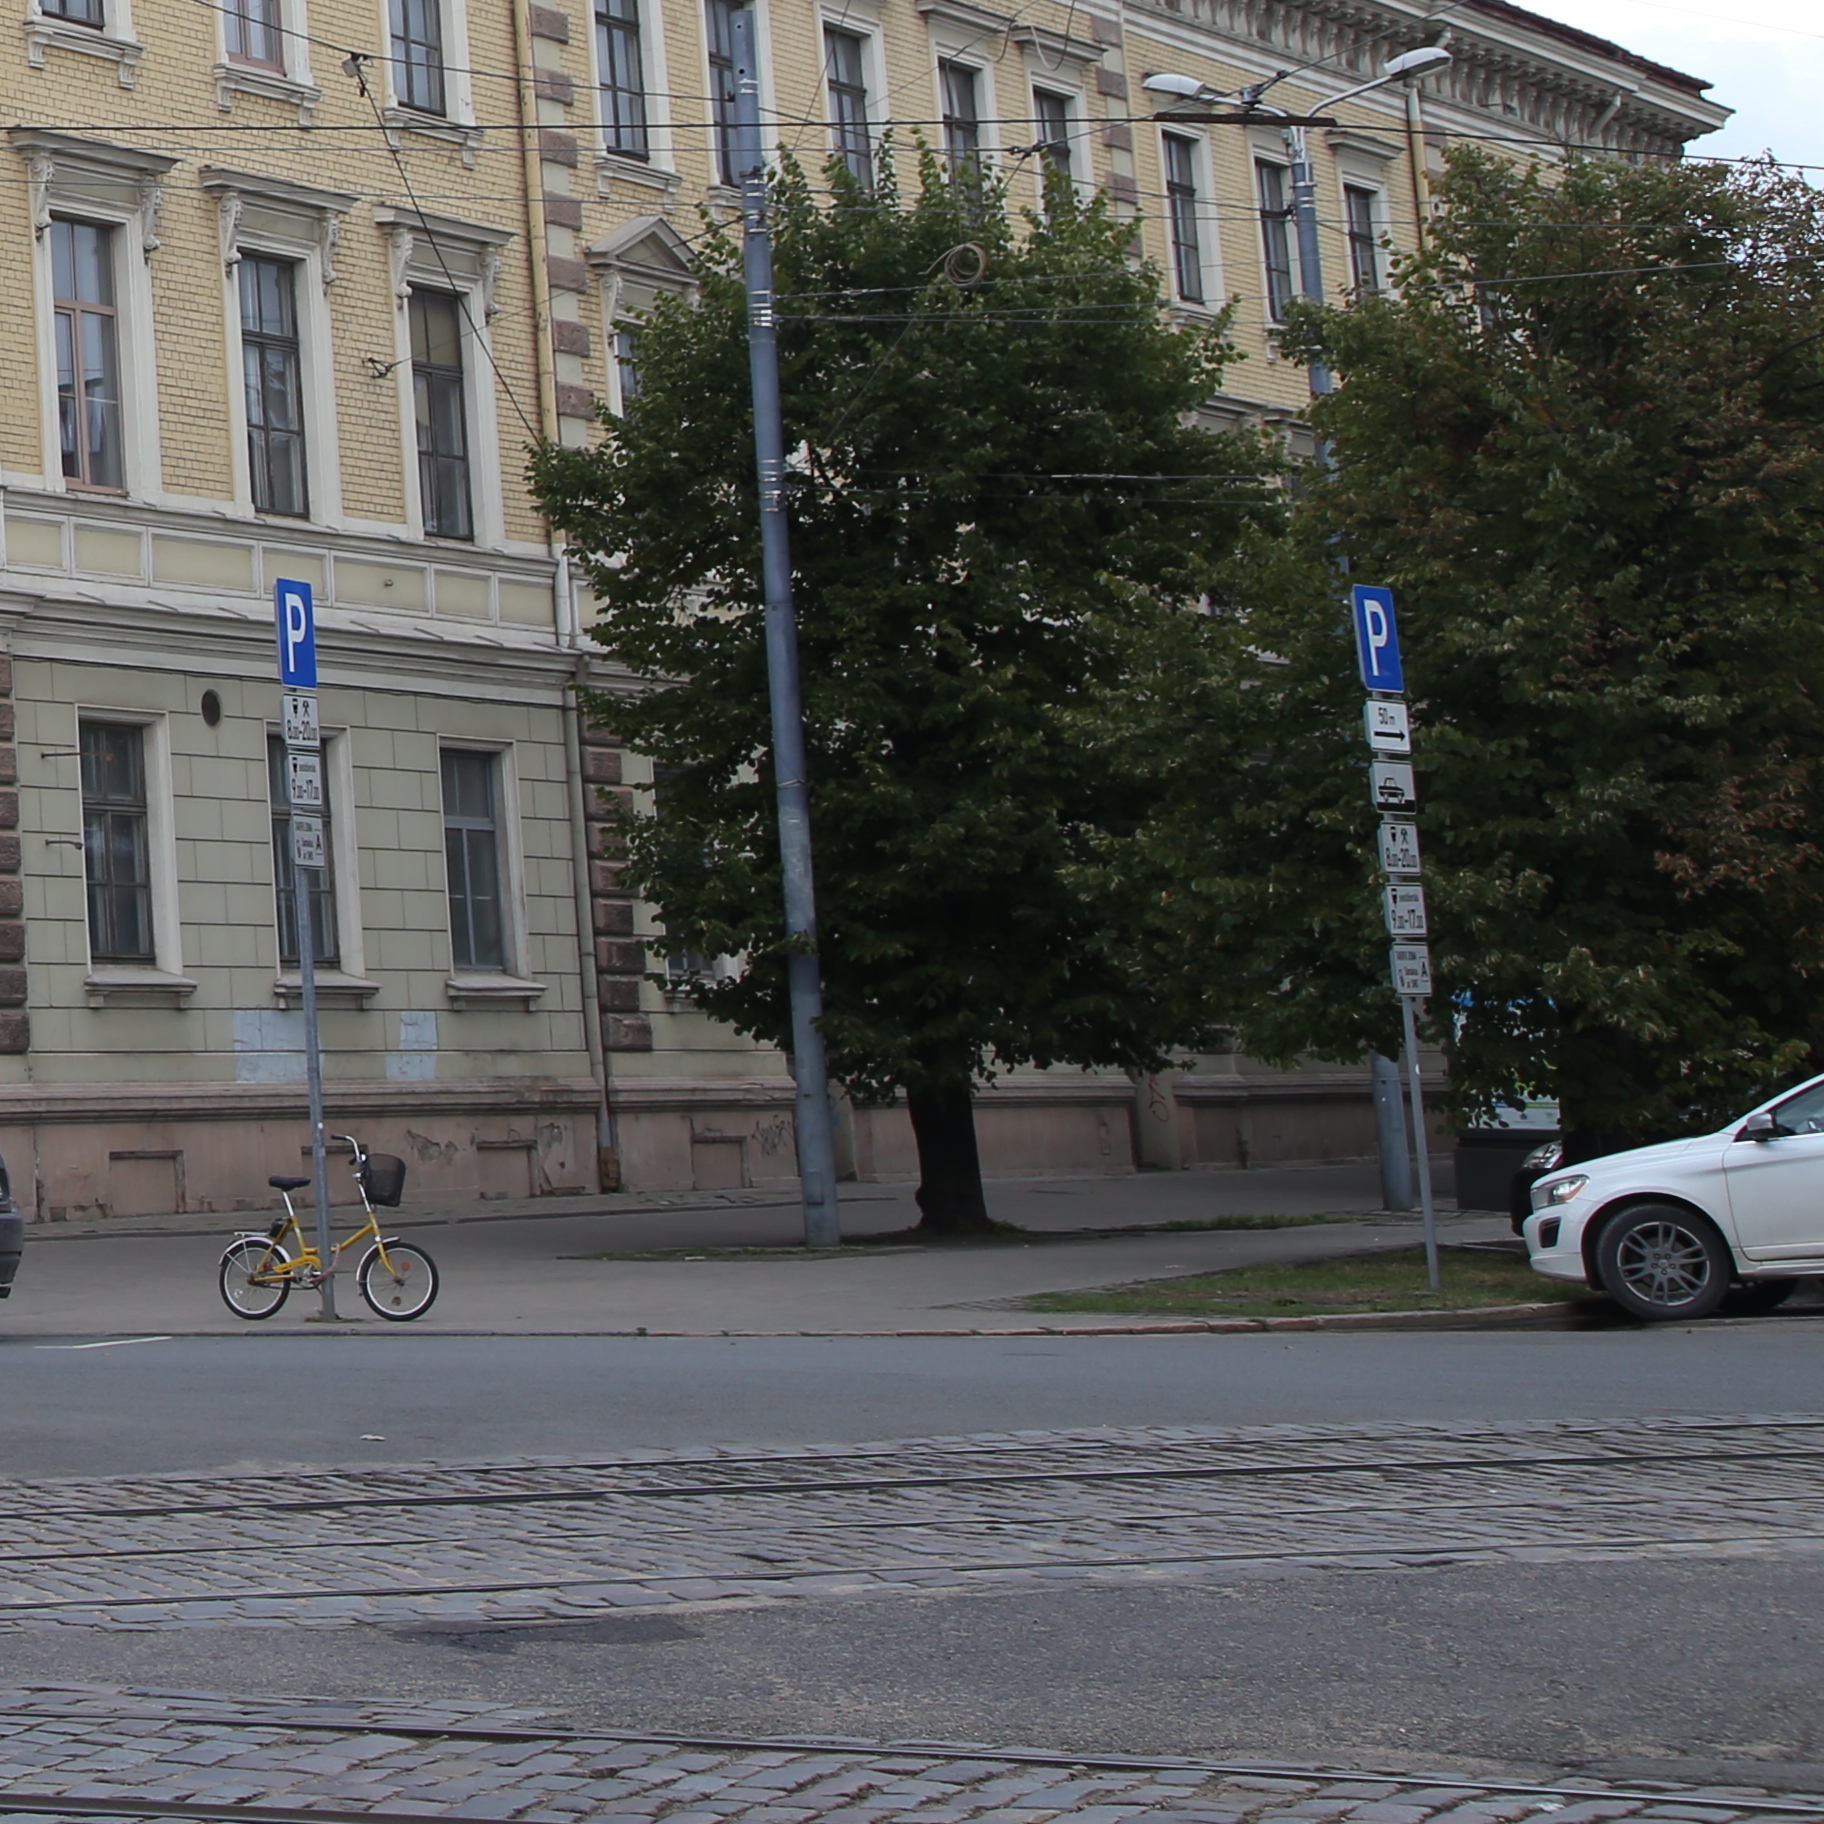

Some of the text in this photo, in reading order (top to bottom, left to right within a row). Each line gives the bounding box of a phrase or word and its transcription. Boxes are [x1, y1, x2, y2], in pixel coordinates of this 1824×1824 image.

[285, 593, 306, 672] P
[1363, 598, 1388, 676] P
[1378, 707, 1388, 725] 50
